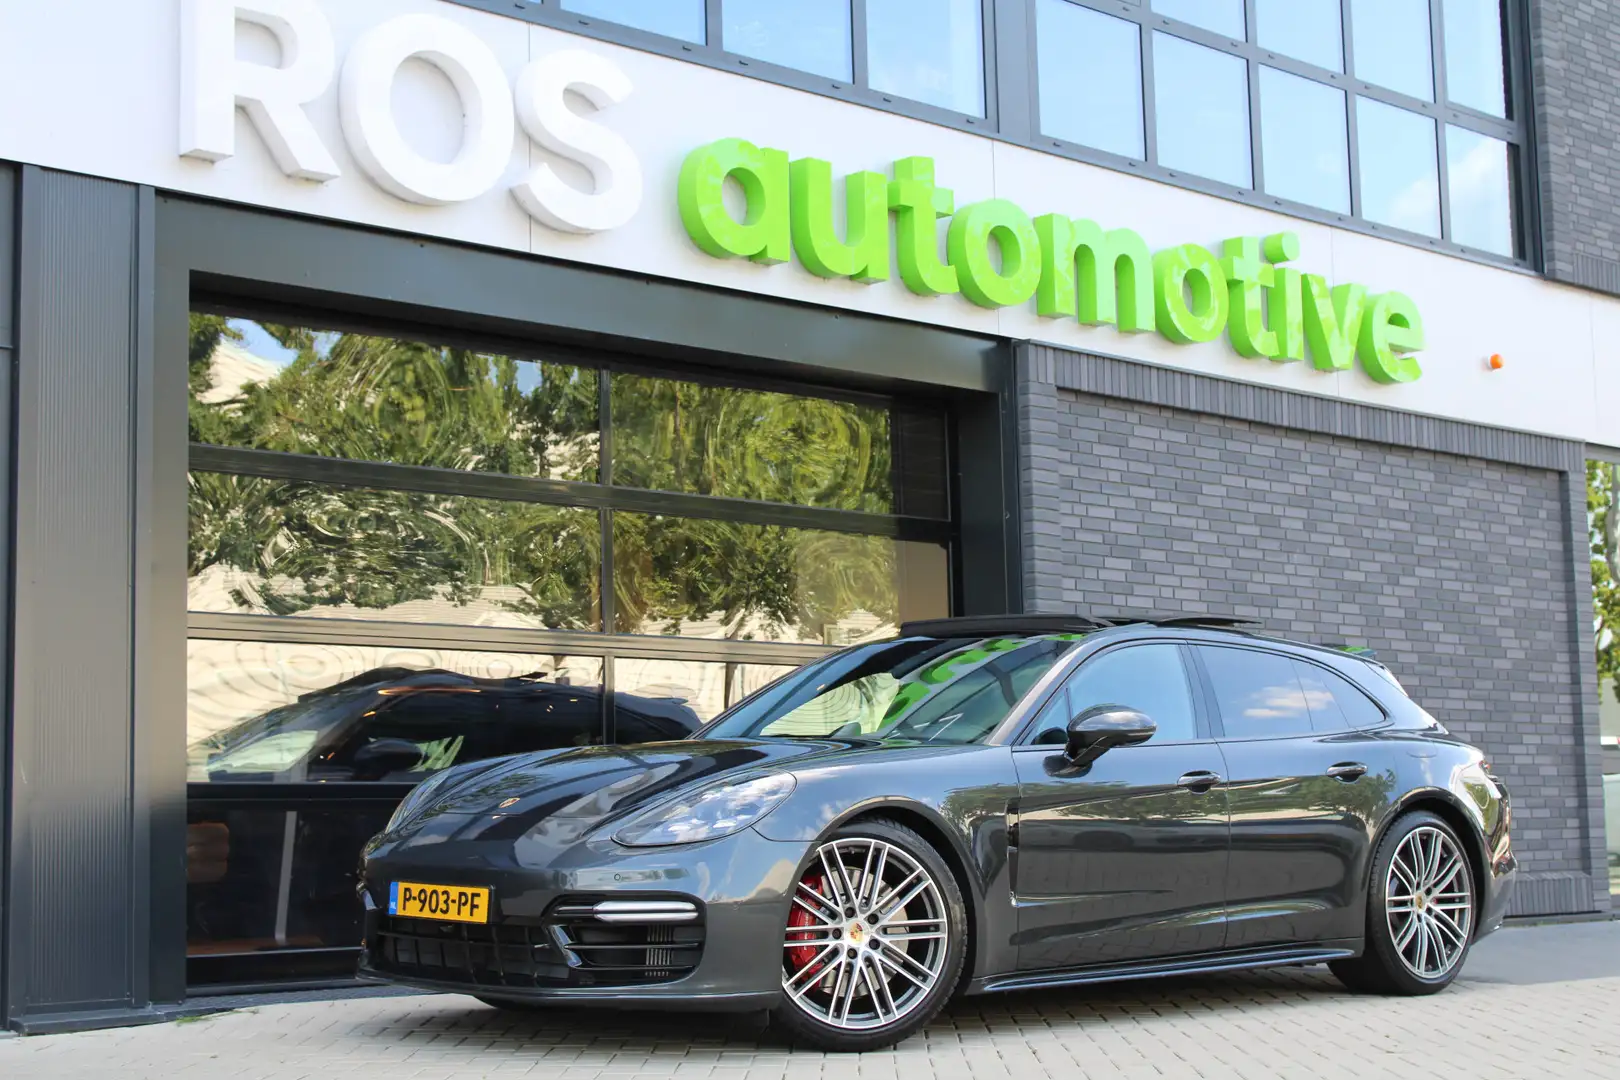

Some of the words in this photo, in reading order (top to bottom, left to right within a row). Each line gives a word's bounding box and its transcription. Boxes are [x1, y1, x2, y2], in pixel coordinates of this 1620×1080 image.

[179, 0, 643, 235] ROS
[677, 138, 1425, 384] automotive
[402, 887, 481, 917] P-903-PF
